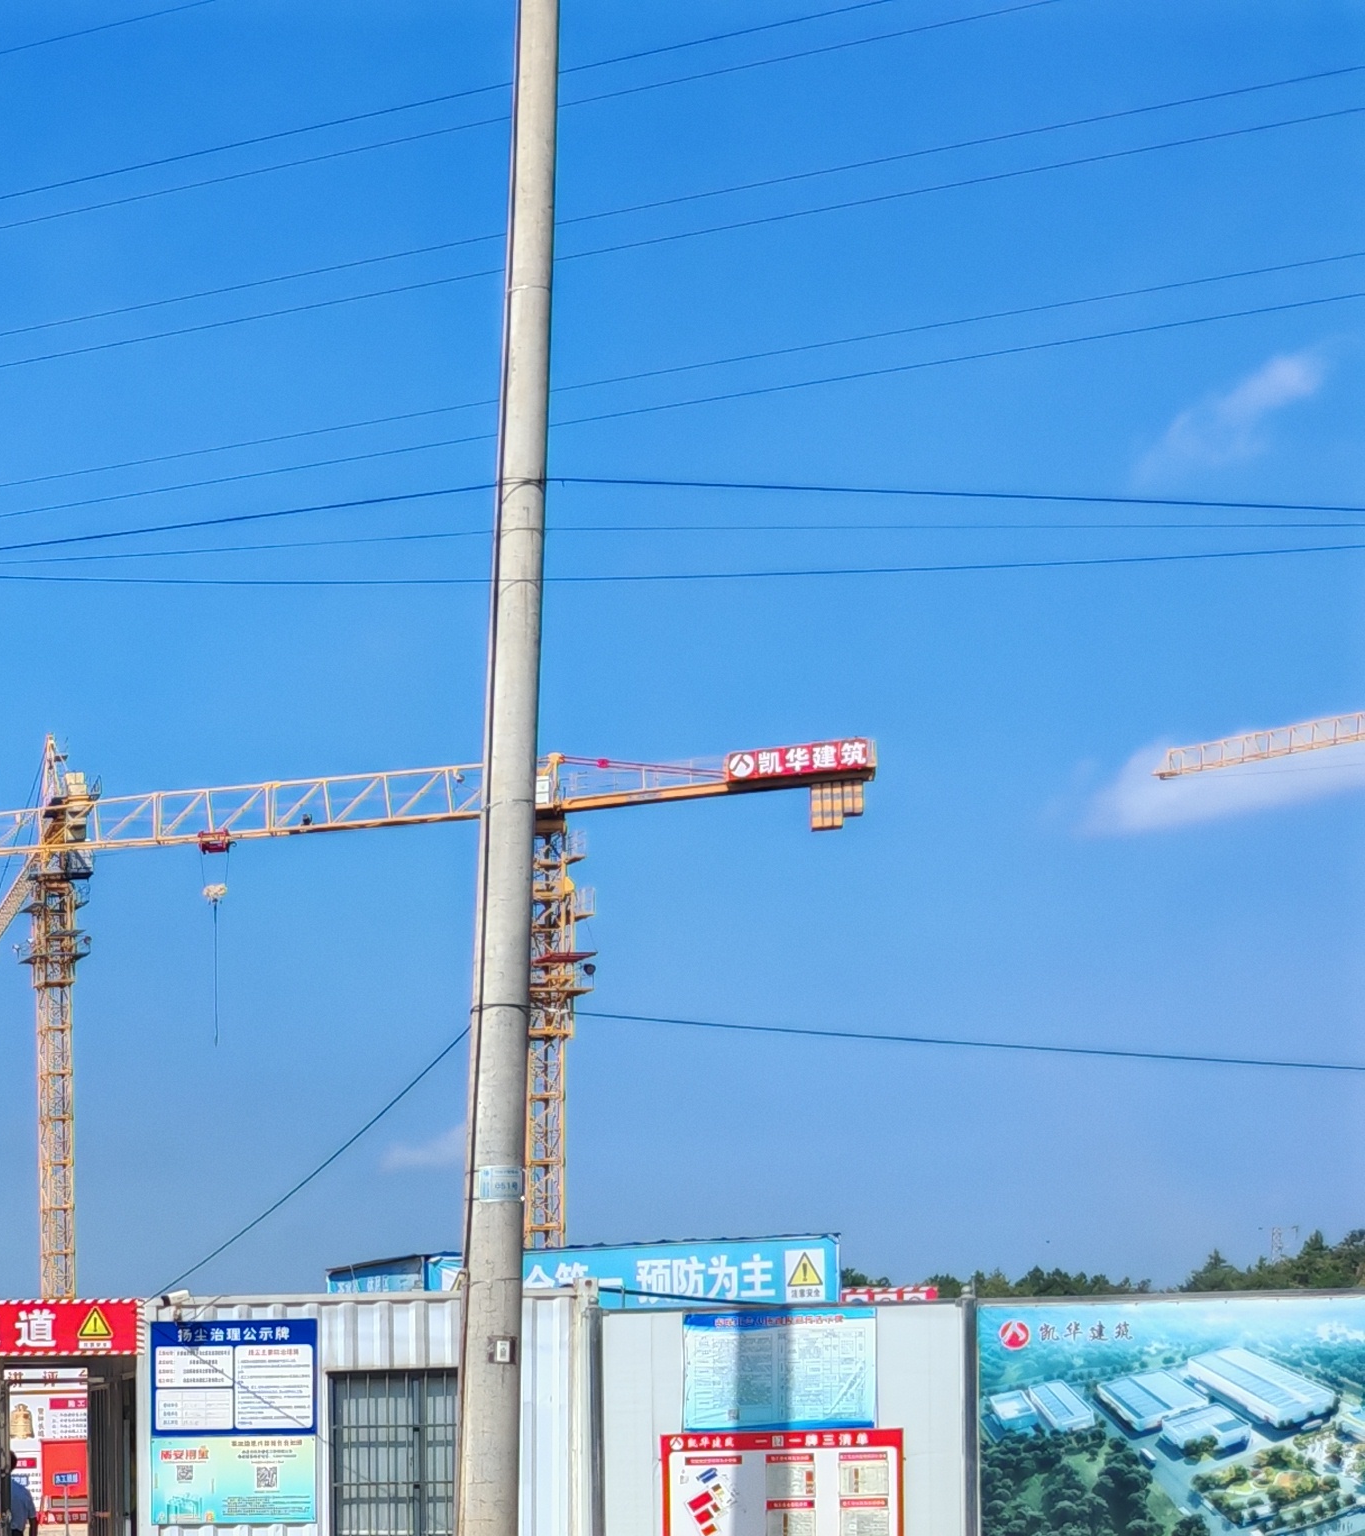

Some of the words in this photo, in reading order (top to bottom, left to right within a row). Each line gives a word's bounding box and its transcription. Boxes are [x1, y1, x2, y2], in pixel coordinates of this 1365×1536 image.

[758, 741, 867, 775] 凯华建筑
[636, 1253, 776, 1305] 预防为主
[177, 1326, 290, 1342] 扬尘治理公示牌
[1039, 1321, 1133, 1342] 凯华建筑
